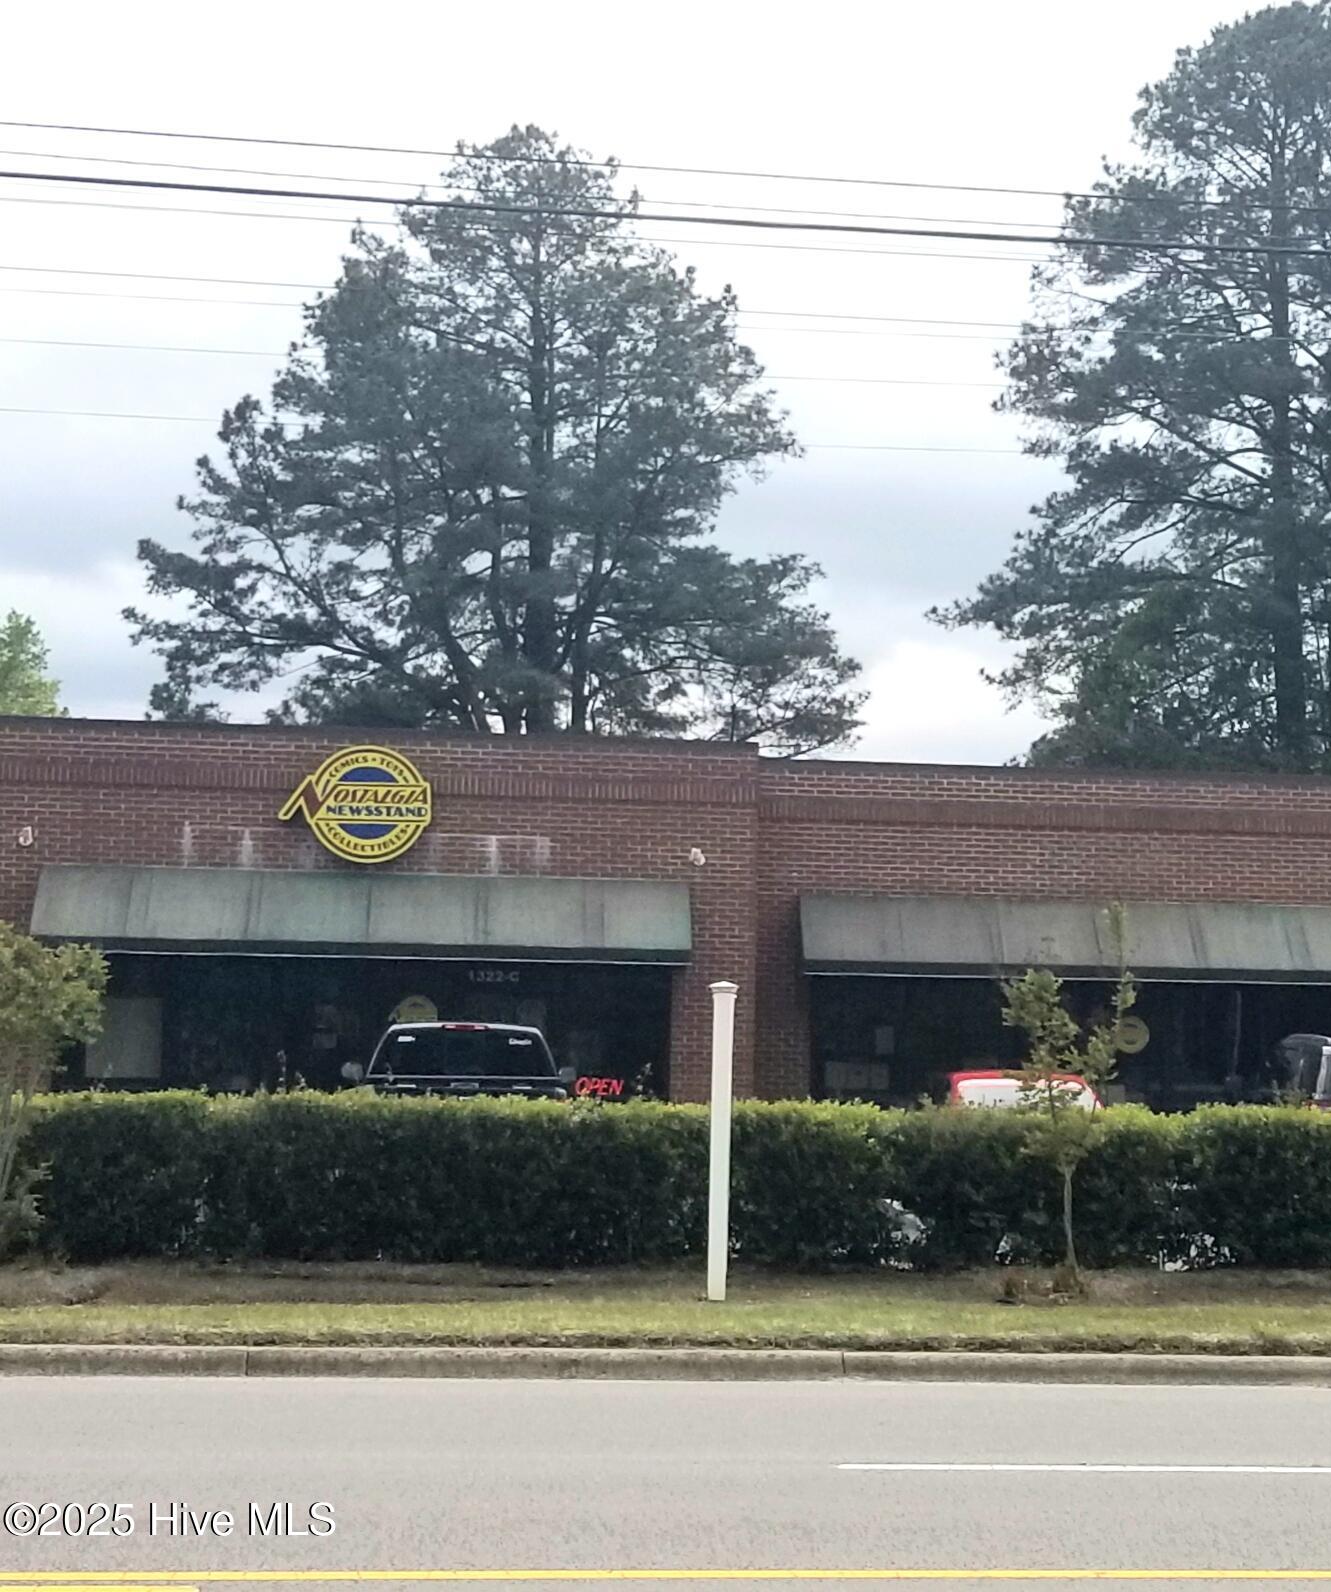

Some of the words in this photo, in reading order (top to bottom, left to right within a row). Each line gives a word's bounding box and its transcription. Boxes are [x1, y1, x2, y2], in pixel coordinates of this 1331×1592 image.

[328, 756, 369, 778] COMICS
[279, 776, 429, 820] NOSTALGIA
[326, 805, 428, 817] NEWSSTAND
[327, 827, 408, 852] COLLECTIBLES
[469, 970, 520, 983] 1322-C
[574, 1076, 624, 1096] OPEN
